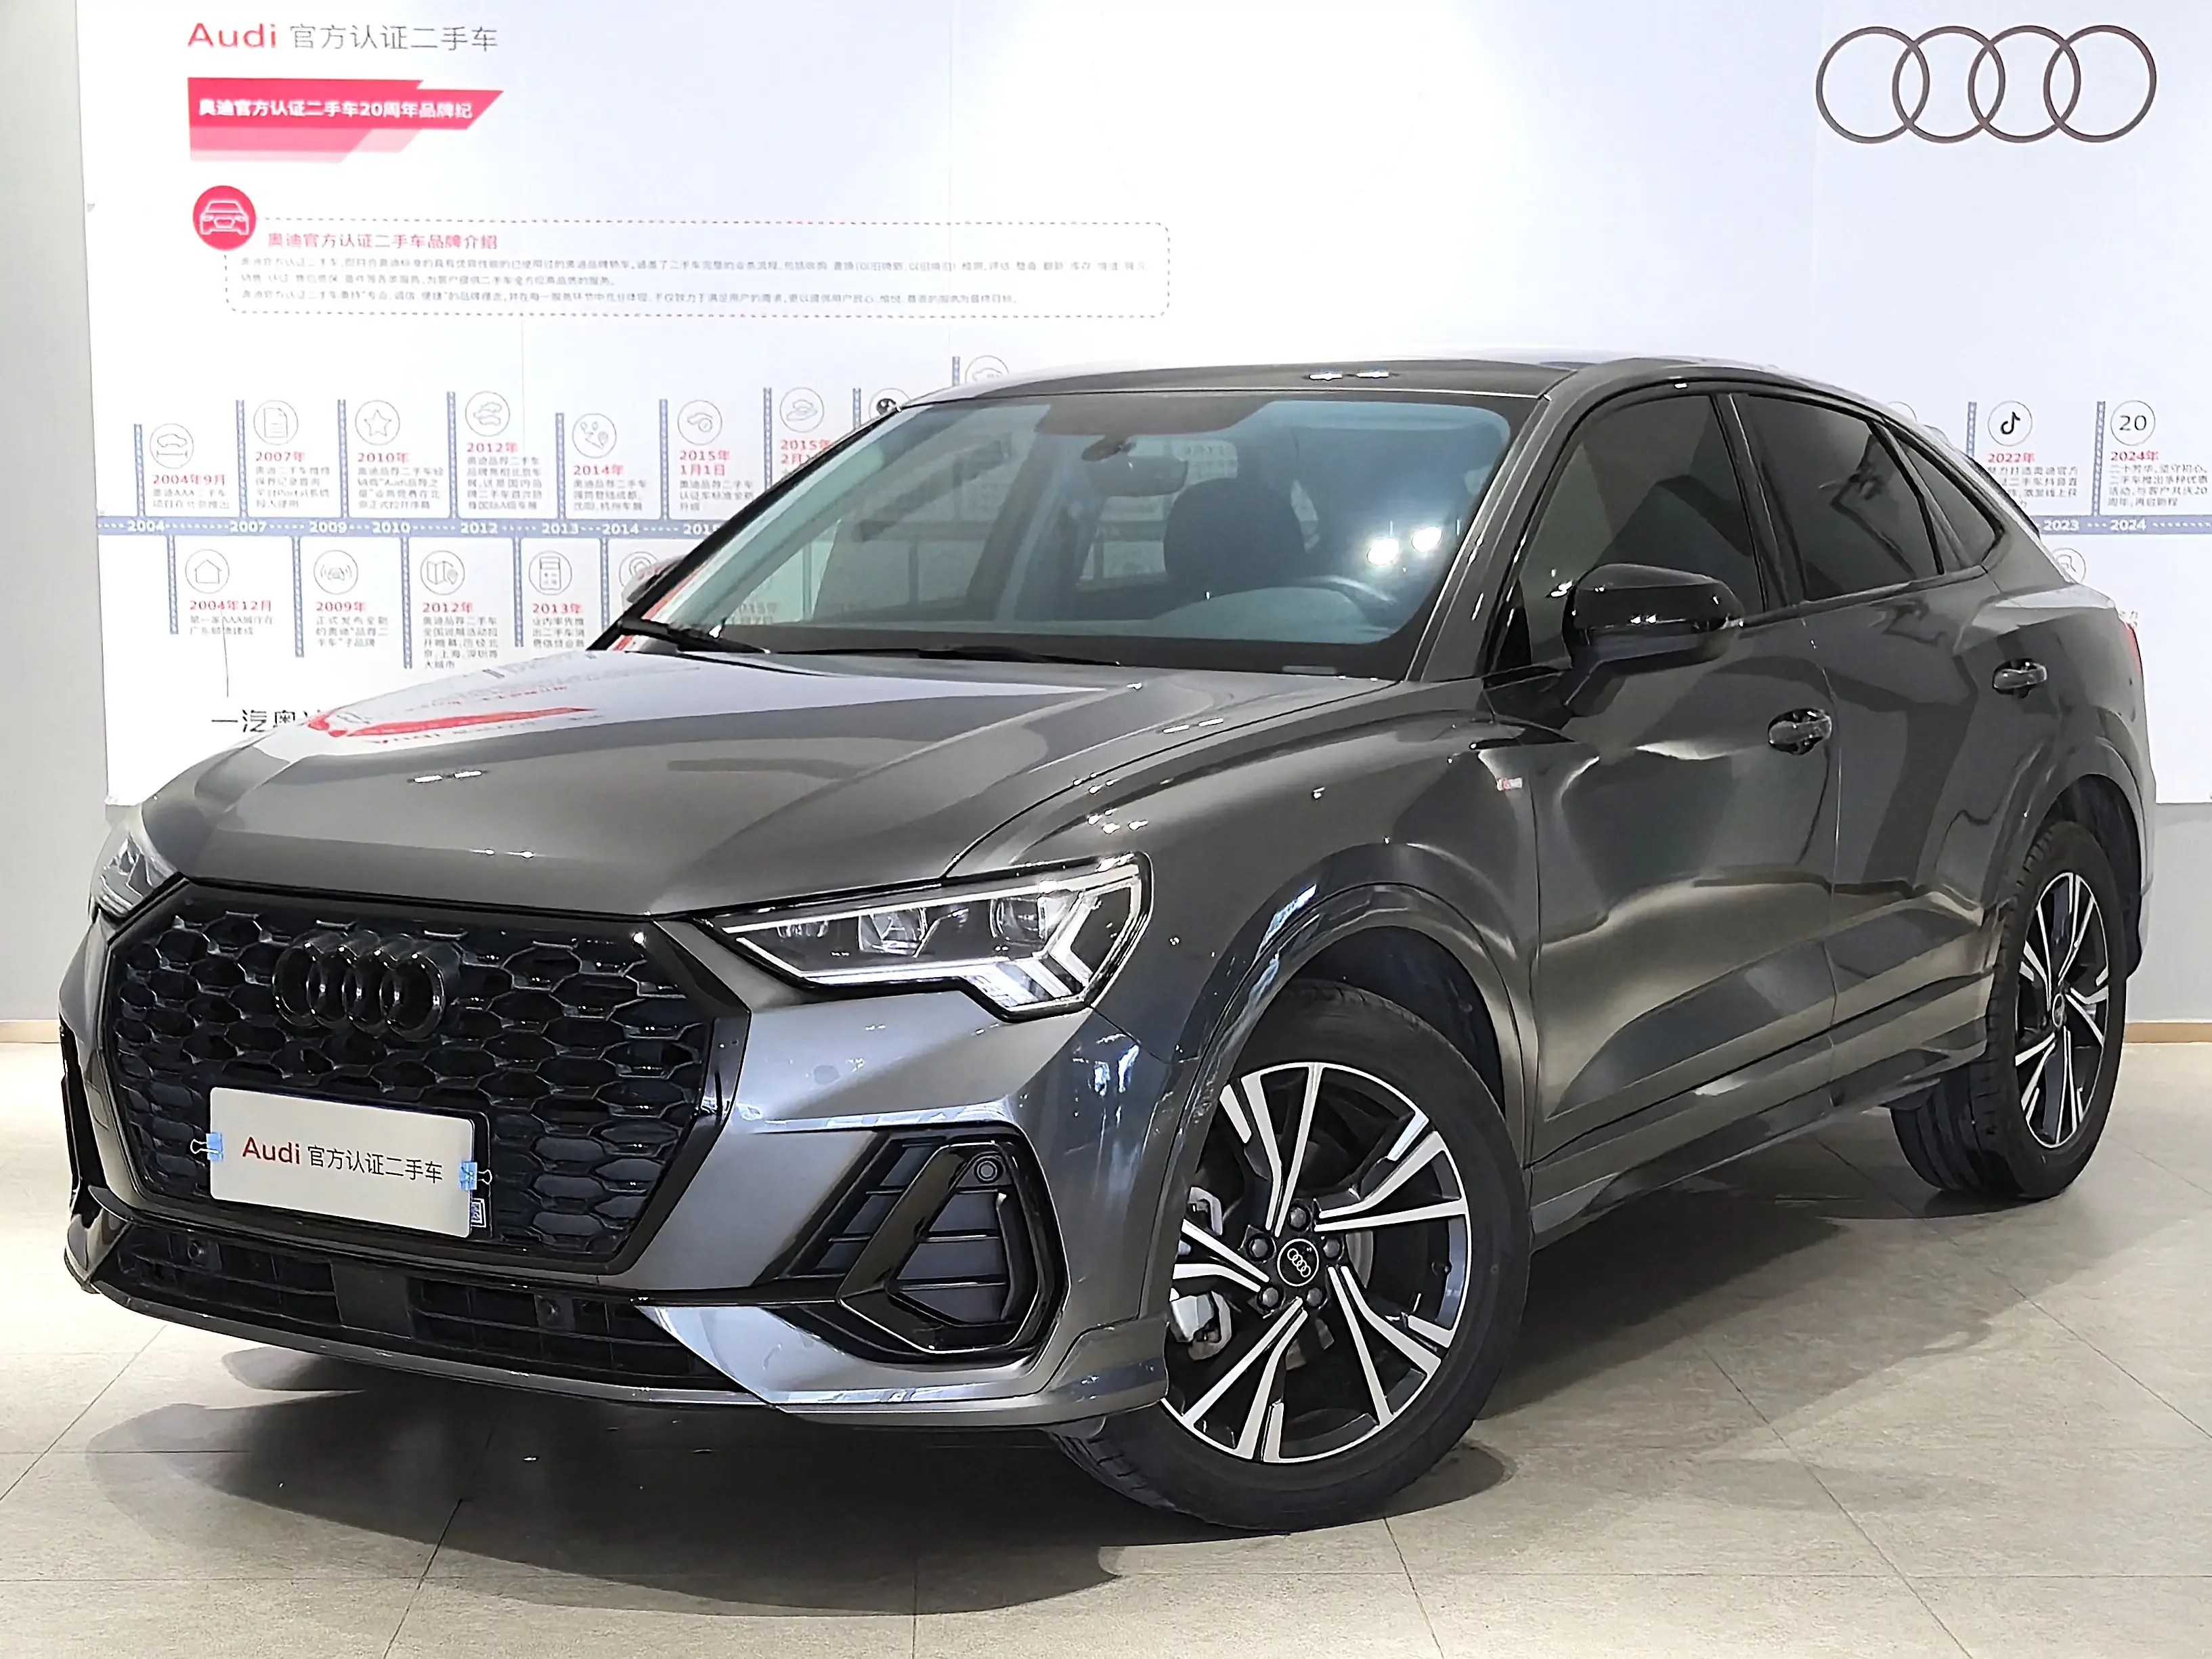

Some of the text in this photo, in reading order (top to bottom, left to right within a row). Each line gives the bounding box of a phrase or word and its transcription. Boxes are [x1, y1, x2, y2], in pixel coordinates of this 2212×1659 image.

[188, 22, 498, 51] Audi 官方认证二手车
[269, 233, 497, 250] 奥迪官方认证二手车品牌介绍
[2119, 414, 2146, 431] 20
[467, 441, 517, 454] 2012年
[256, 451, 304, 462] 2007年
[357, 452, 408, 464] 2010年
[678, 449, 731, 462] 2015年
[1986, 451, 2036, 465] 2022年
[2111, 450, 2159, 461] 2024年
[573, 464, 623, 476] 2014年
[679, 464, 726, 477] 1月1日
[154, 474, 224, 486] 2004年9月
[127, 519, 165, 532] 2004
[229, 520, 267, 534] 2007
[309, 520, 348, 534] 2009
[372, 521, 411, 534] 2010
[460, 522, 498, 535] 2012
[542, 522, 579, 535] 2013
[601, 523, 640, 536] 2014
[2043, 519, 2147, 532] 2023 2024
[190, 600, 271, 611] 2004年12月
[317, 601, 364, 612] 2009年
[423, 601, 472, 614] 2012年
[532, 603, 583, 615] 2013年
[242, 1136, 443, 1184] Audi 官方认证二手车
